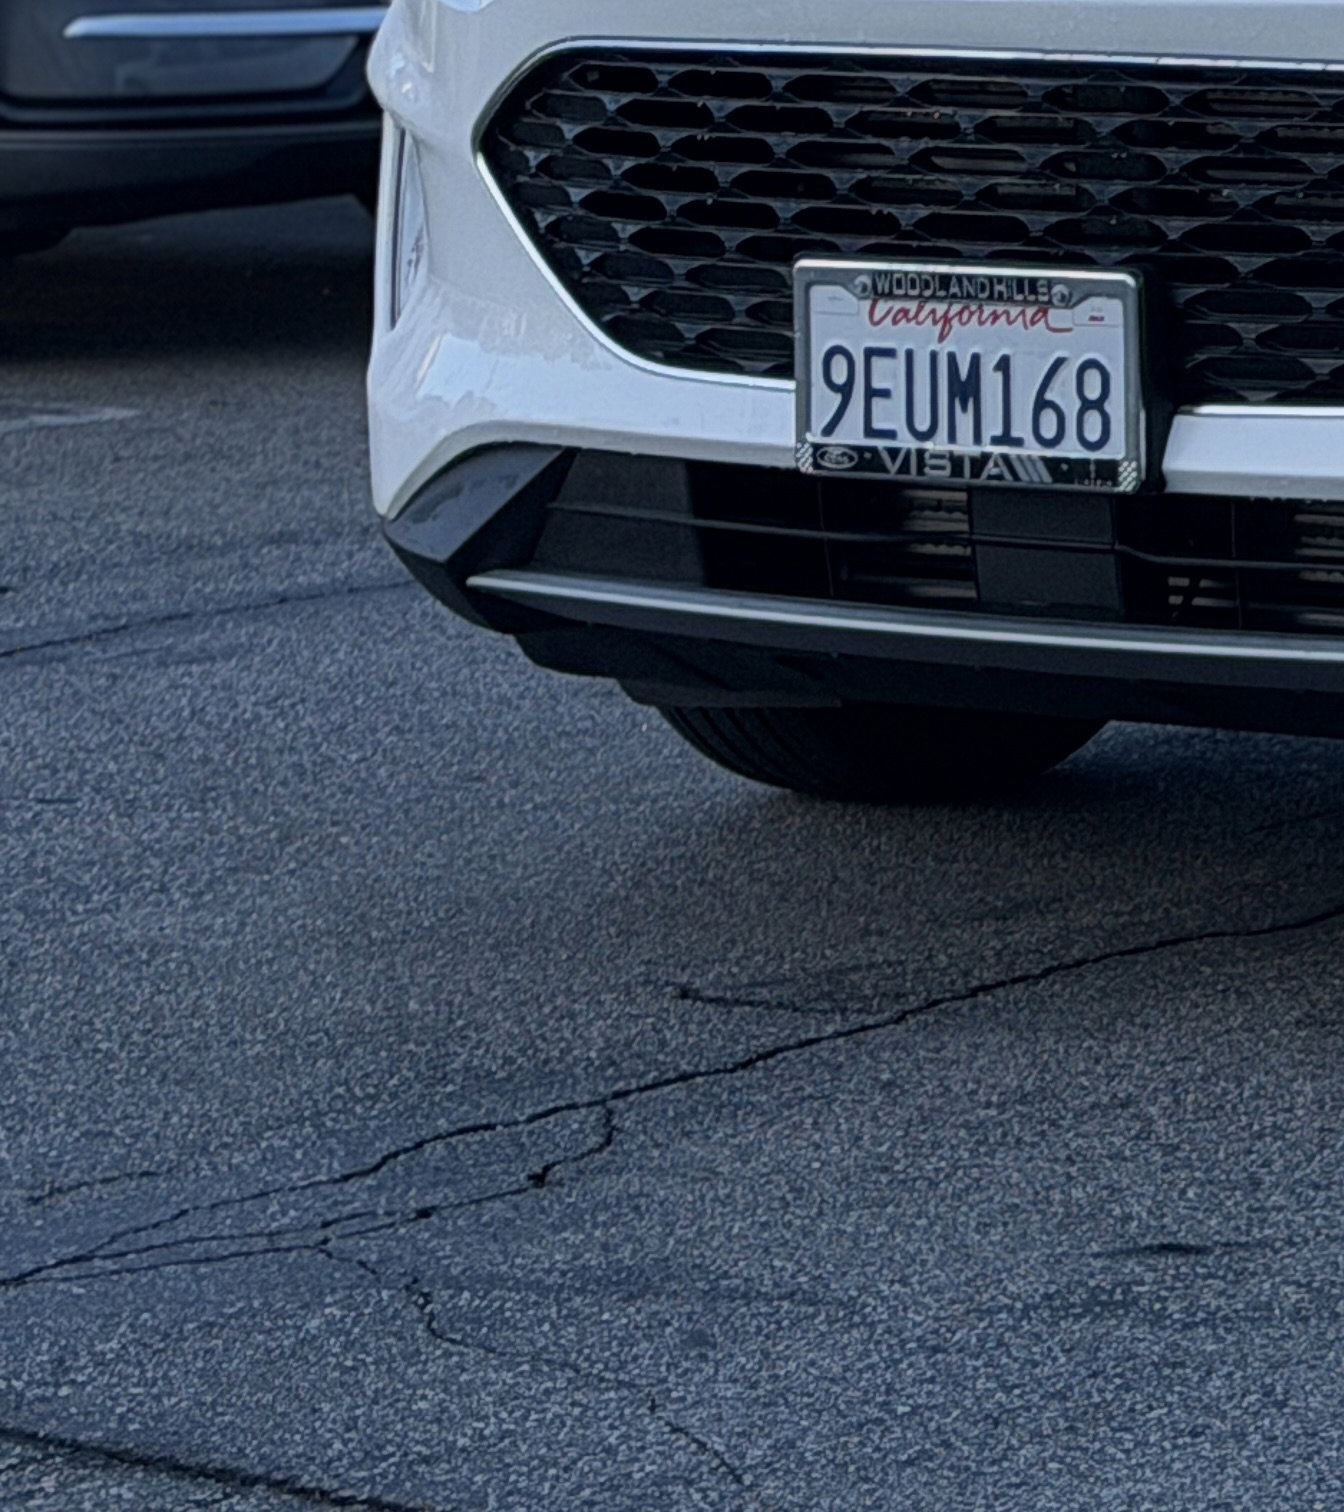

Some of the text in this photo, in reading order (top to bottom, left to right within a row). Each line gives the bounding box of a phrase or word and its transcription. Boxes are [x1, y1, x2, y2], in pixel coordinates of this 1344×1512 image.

[875, 273, 1050, 302] WOODLAND HILLS
[820, 344, 1112, 452] 9EUM168
[876, 447, 1013, 481] VISTA
